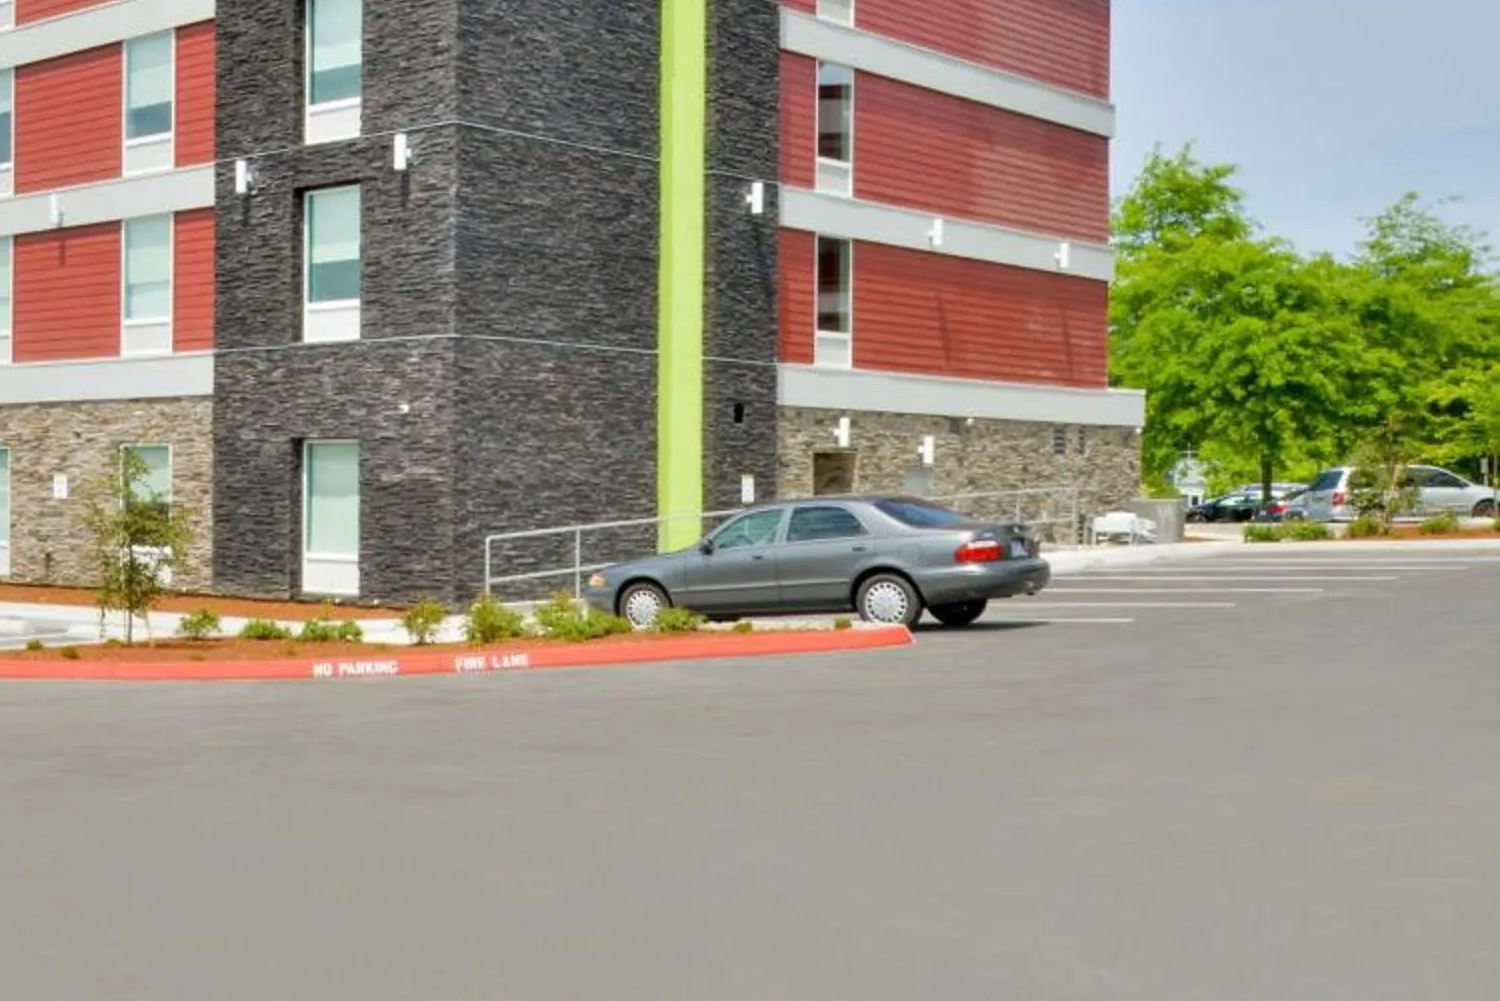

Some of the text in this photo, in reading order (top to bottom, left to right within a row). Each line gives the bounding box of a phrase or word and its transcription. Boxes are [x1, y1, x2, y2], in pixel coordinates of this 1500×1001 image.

[313, 660, 399, 678] NO PARKING
[454, 652, 529, 672] FIRE LANE
